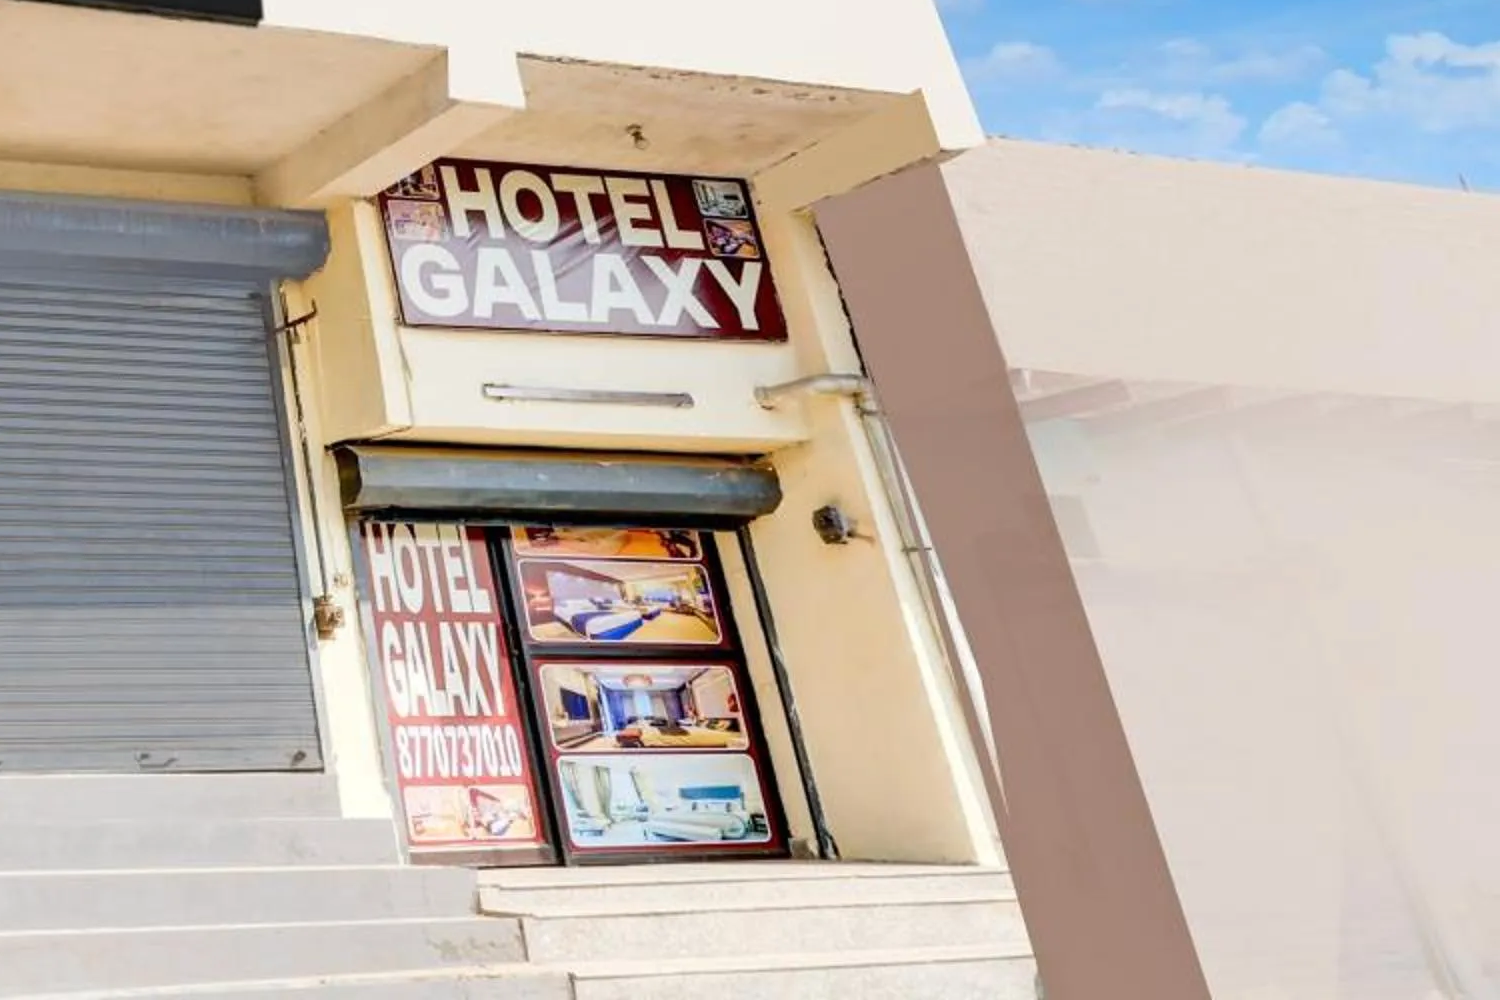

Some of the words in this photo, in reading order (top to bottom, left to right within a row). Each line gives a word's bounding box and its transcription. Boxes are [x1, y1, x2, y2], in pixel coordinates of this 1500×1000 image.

[439, 165, 705, 251] HOTEL
[400, 243, 762, 330] GALAXY
[365, 523, 491, 613] HOTEL
[381, 620, 504, 717] GALAXY
[396, 724, 523, 778] 8770737010
